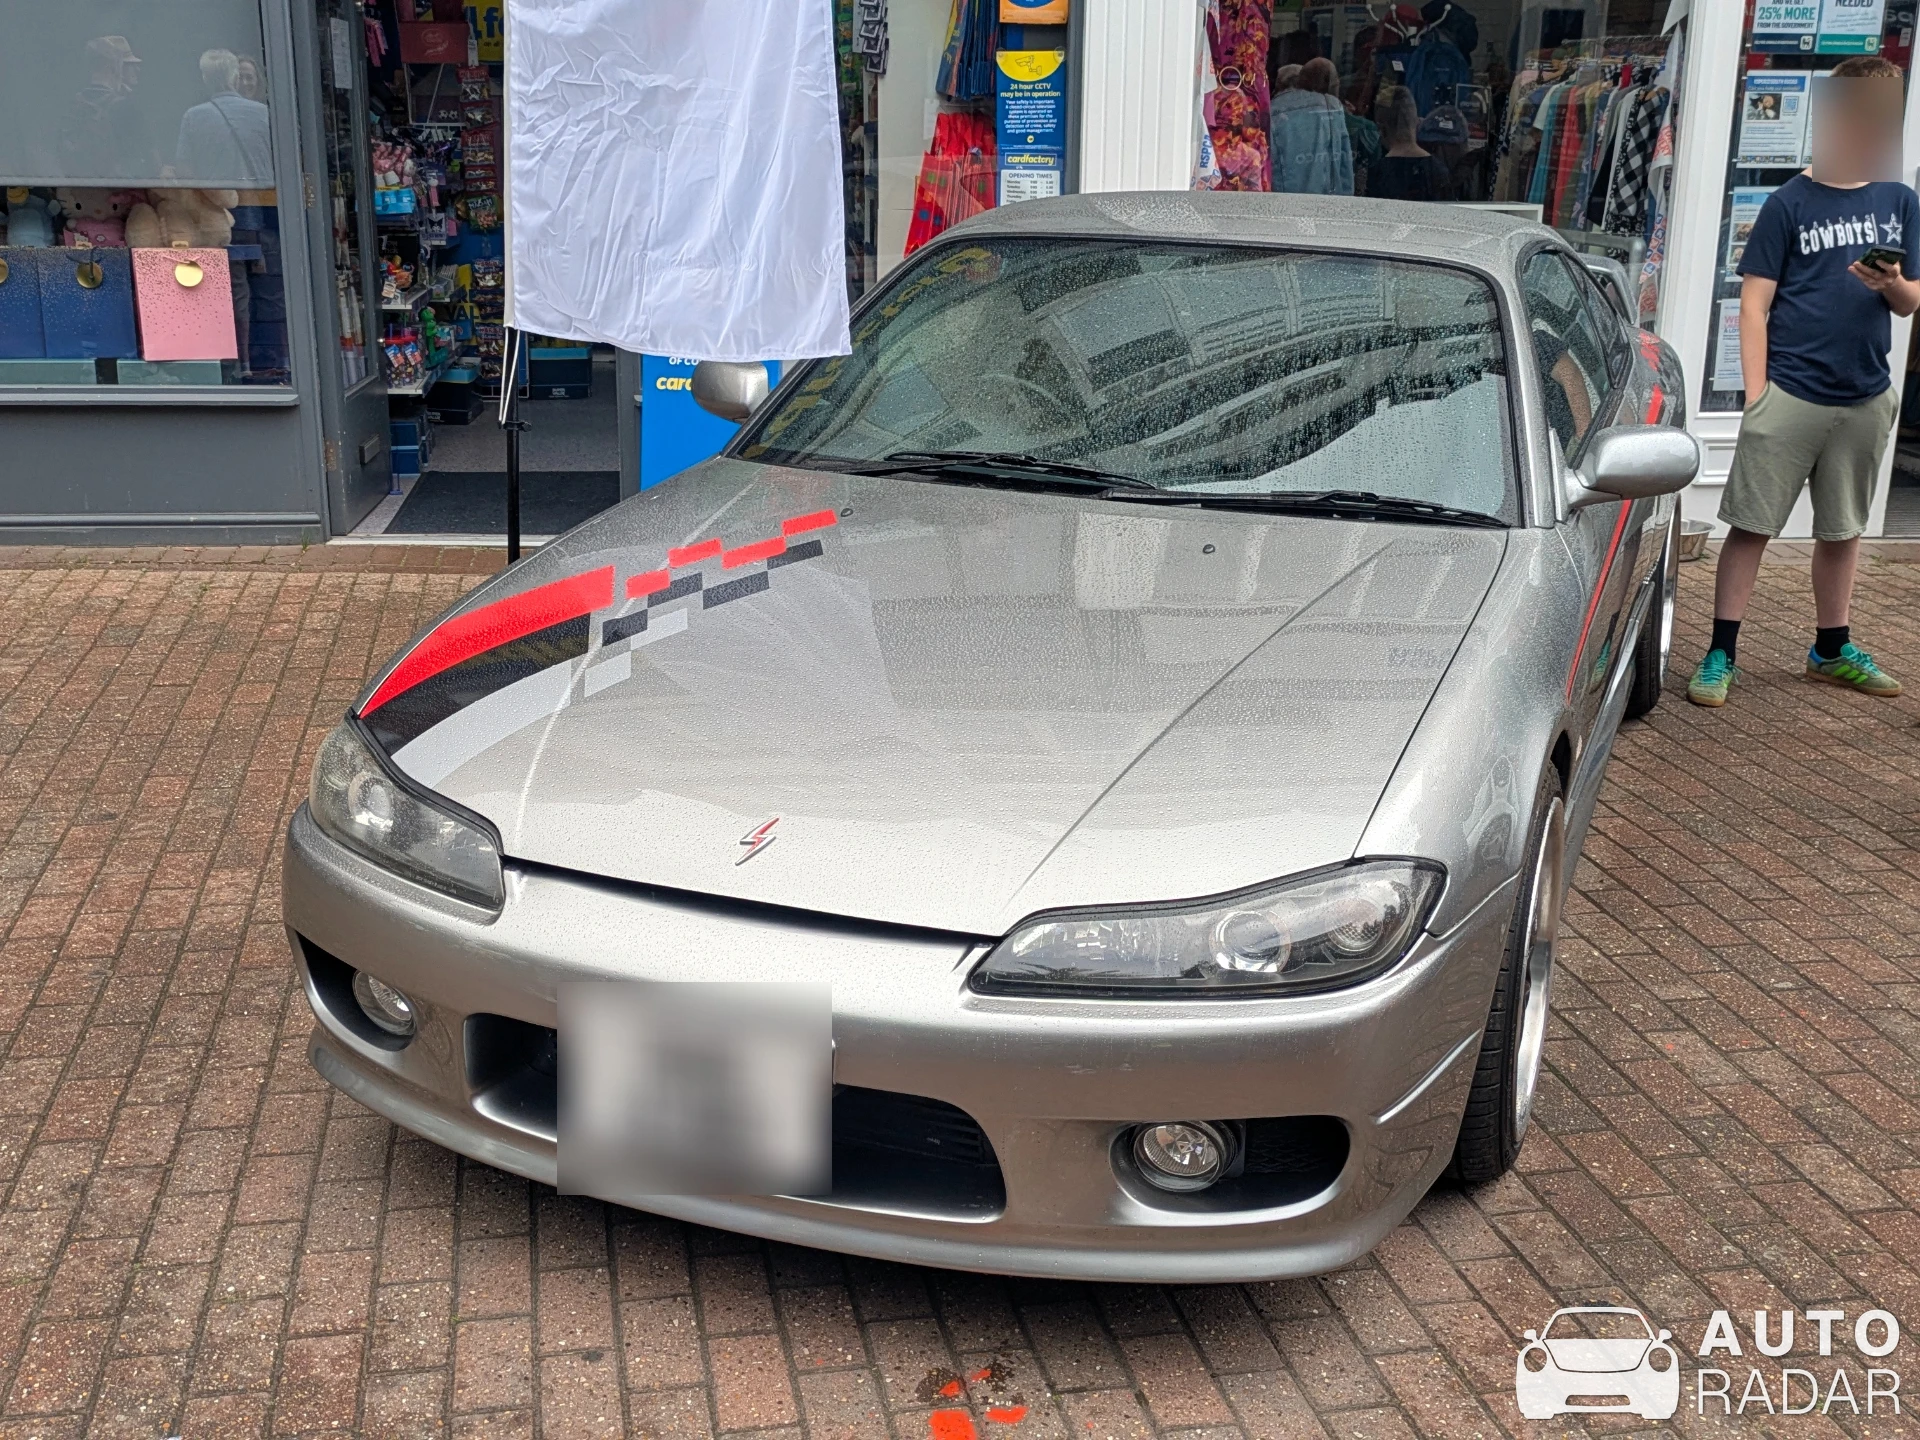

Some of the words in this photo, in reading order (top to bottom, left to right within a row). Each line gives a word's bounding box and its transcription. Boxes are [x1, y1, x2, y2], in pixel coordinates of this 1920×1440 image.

[1758, 7, 1782, 20] 25%
[1784, 7, 1816, 20] MORE
[1007, 153, 1055, 166] cardfactory
[1800, 221, 1875, 255] COWBOYS
[669, 357, 682, 365] OF
